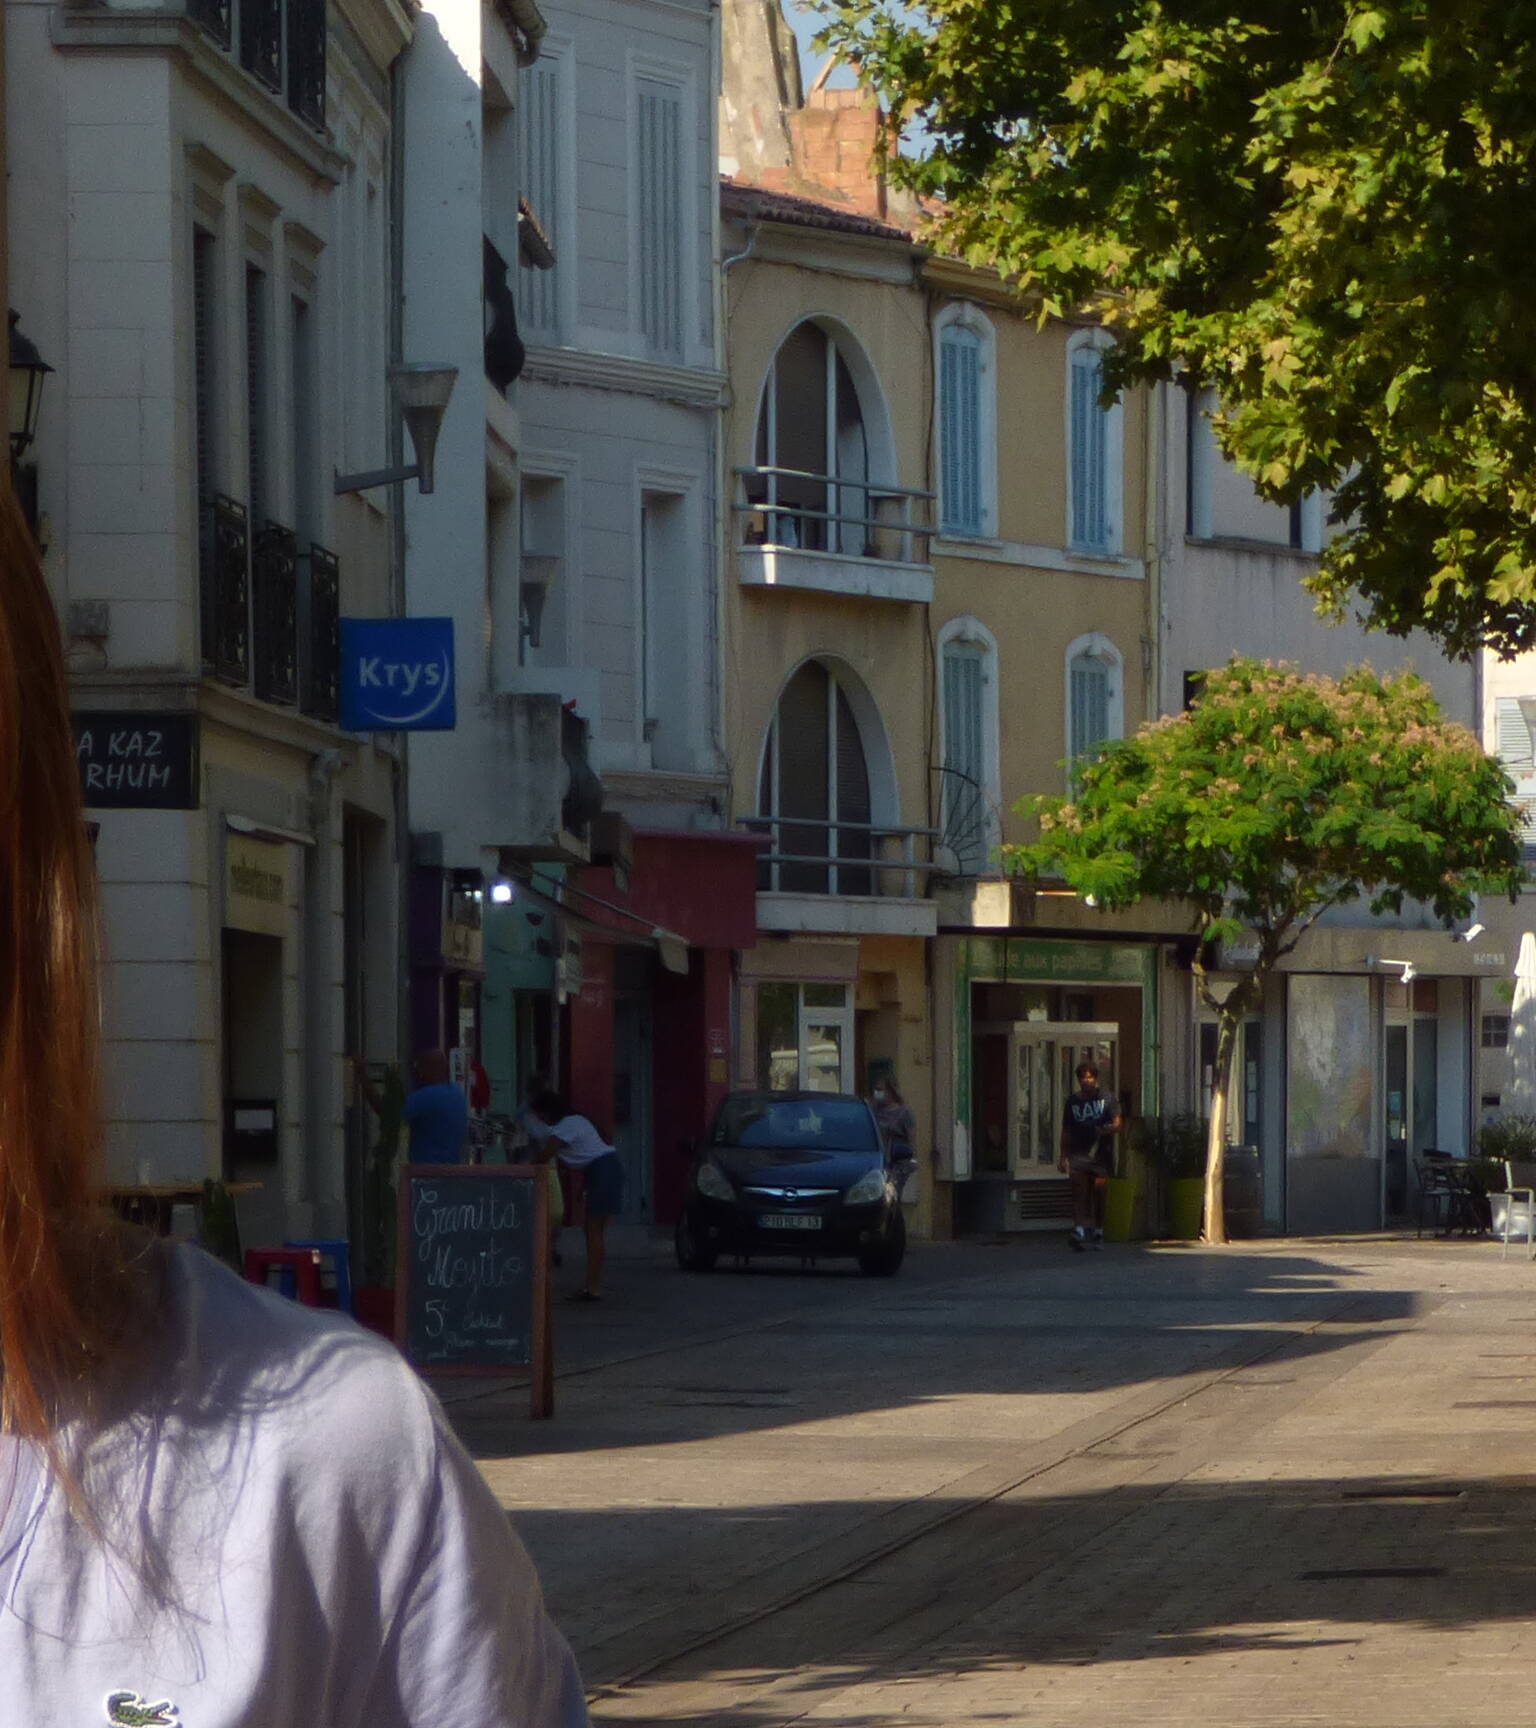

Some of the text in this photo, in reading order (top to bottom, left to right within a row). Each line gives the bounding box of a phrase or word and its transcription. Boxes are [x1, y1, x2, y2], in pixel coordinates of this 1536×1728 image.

[360, 656, 441, 697] Krys
[108, 730, 162, 758] KAZ
[86, 762, 171, 790] RHUM
[1071, 1099, 1105, 1122] RAW
[414, 1185, 521, 1262] Granita
[427, 1236, 522, 1297] Mojito
